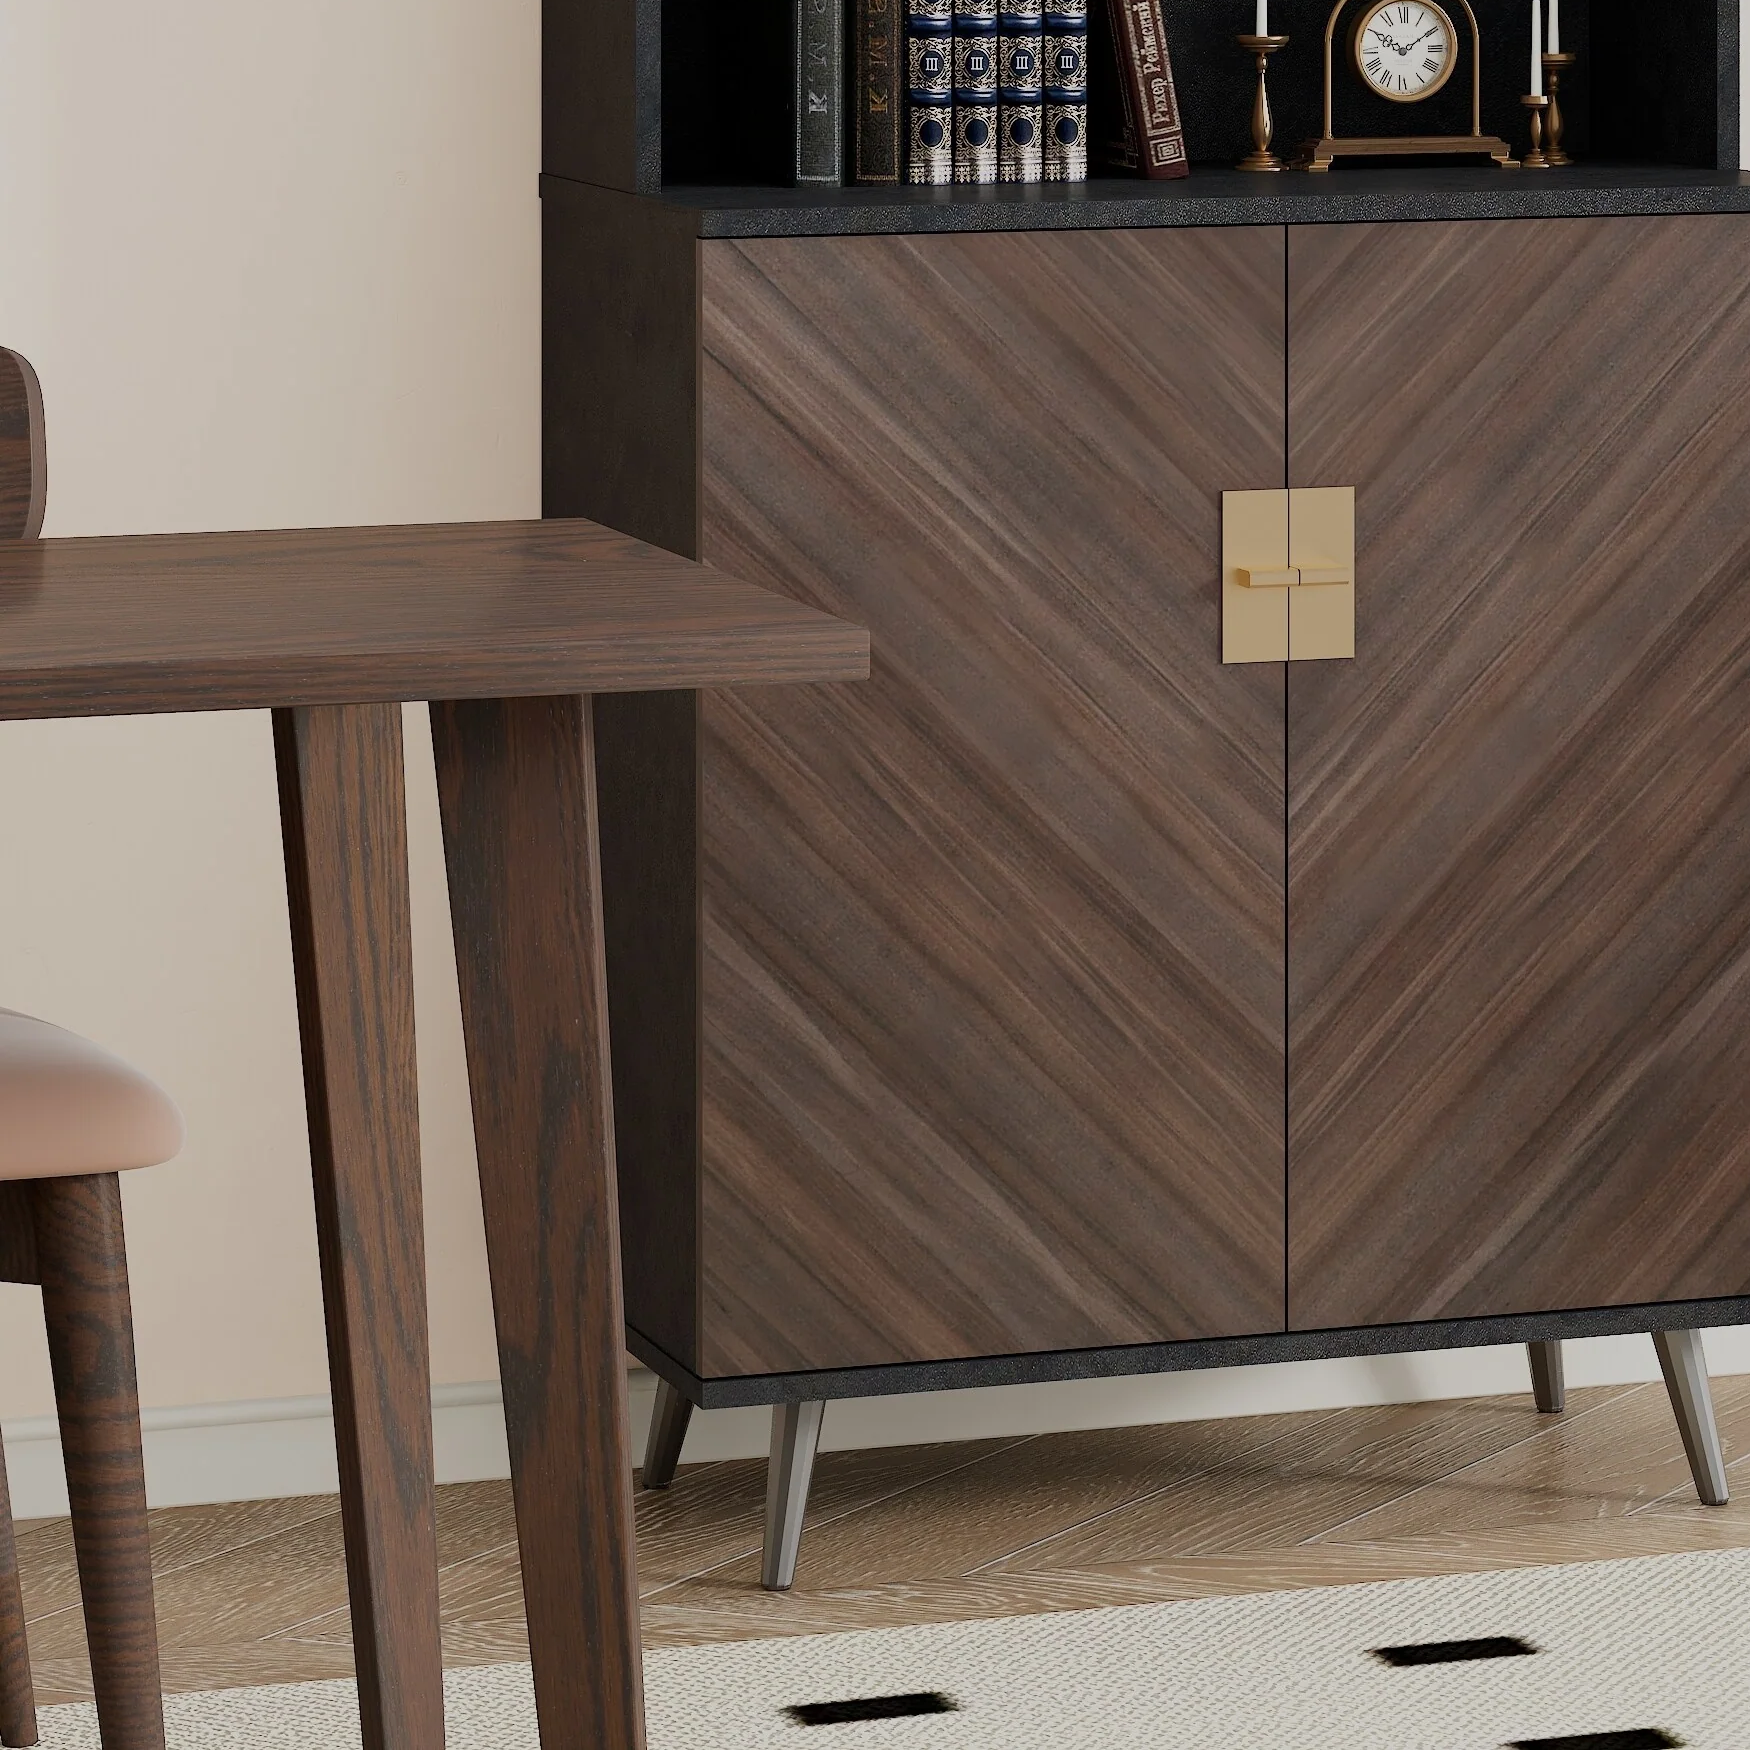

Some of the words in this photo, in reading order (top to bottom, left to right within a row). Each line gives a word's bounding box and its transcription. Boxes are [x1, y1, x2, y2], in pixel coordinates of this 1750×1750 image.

[925, 57, 939, 71] III
[970, 56, 984, 70] III
[1015, 55, 1029, 70] III
[1060, 55, 1074, 69] III
